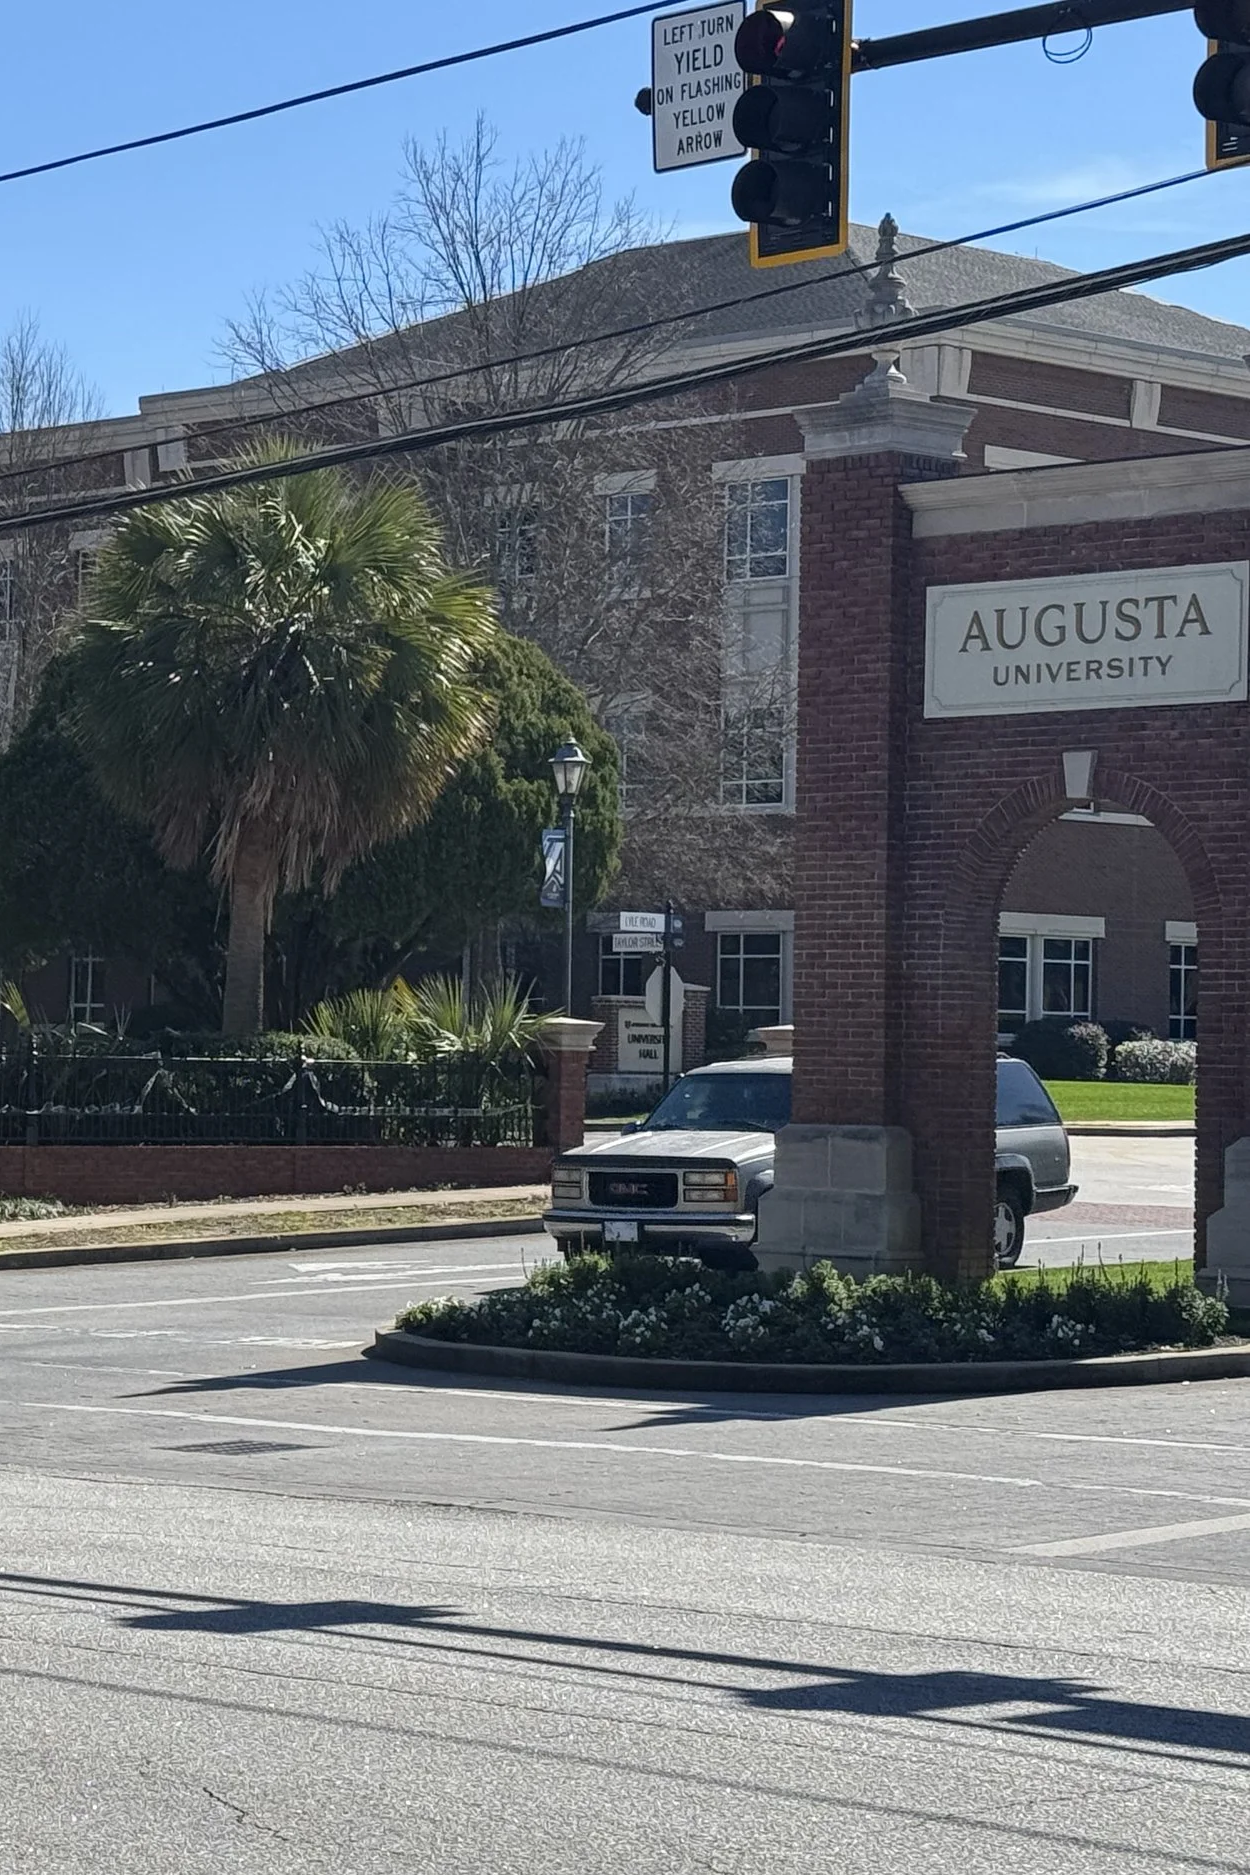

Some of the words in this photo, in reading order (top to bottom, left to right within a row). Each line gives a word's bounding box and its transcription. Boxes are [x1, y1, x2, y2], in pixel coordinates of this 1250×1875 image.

[663, 23, 693, 46] LEFT
[700, 14, 734, 39] TURN
[674, 44, 724, 75] YIELD
[657, 85, 674, 106] ON
[681, 72, 741, 102] FLASHING
[673, 102, 725, 129] YELLOW
[677, 130, 723, 156] ARROW
[958, 593, 1212, 653] AUGUSTA
[993, 655, 1174, 686] UNIVERSITY
[640, 916, 657, 929] ROAD
[614, 936, 639, 949] TAYLOR
[638, 1048, 658, 1059] HALL
[610, 1182, 649, 1195] GMC
